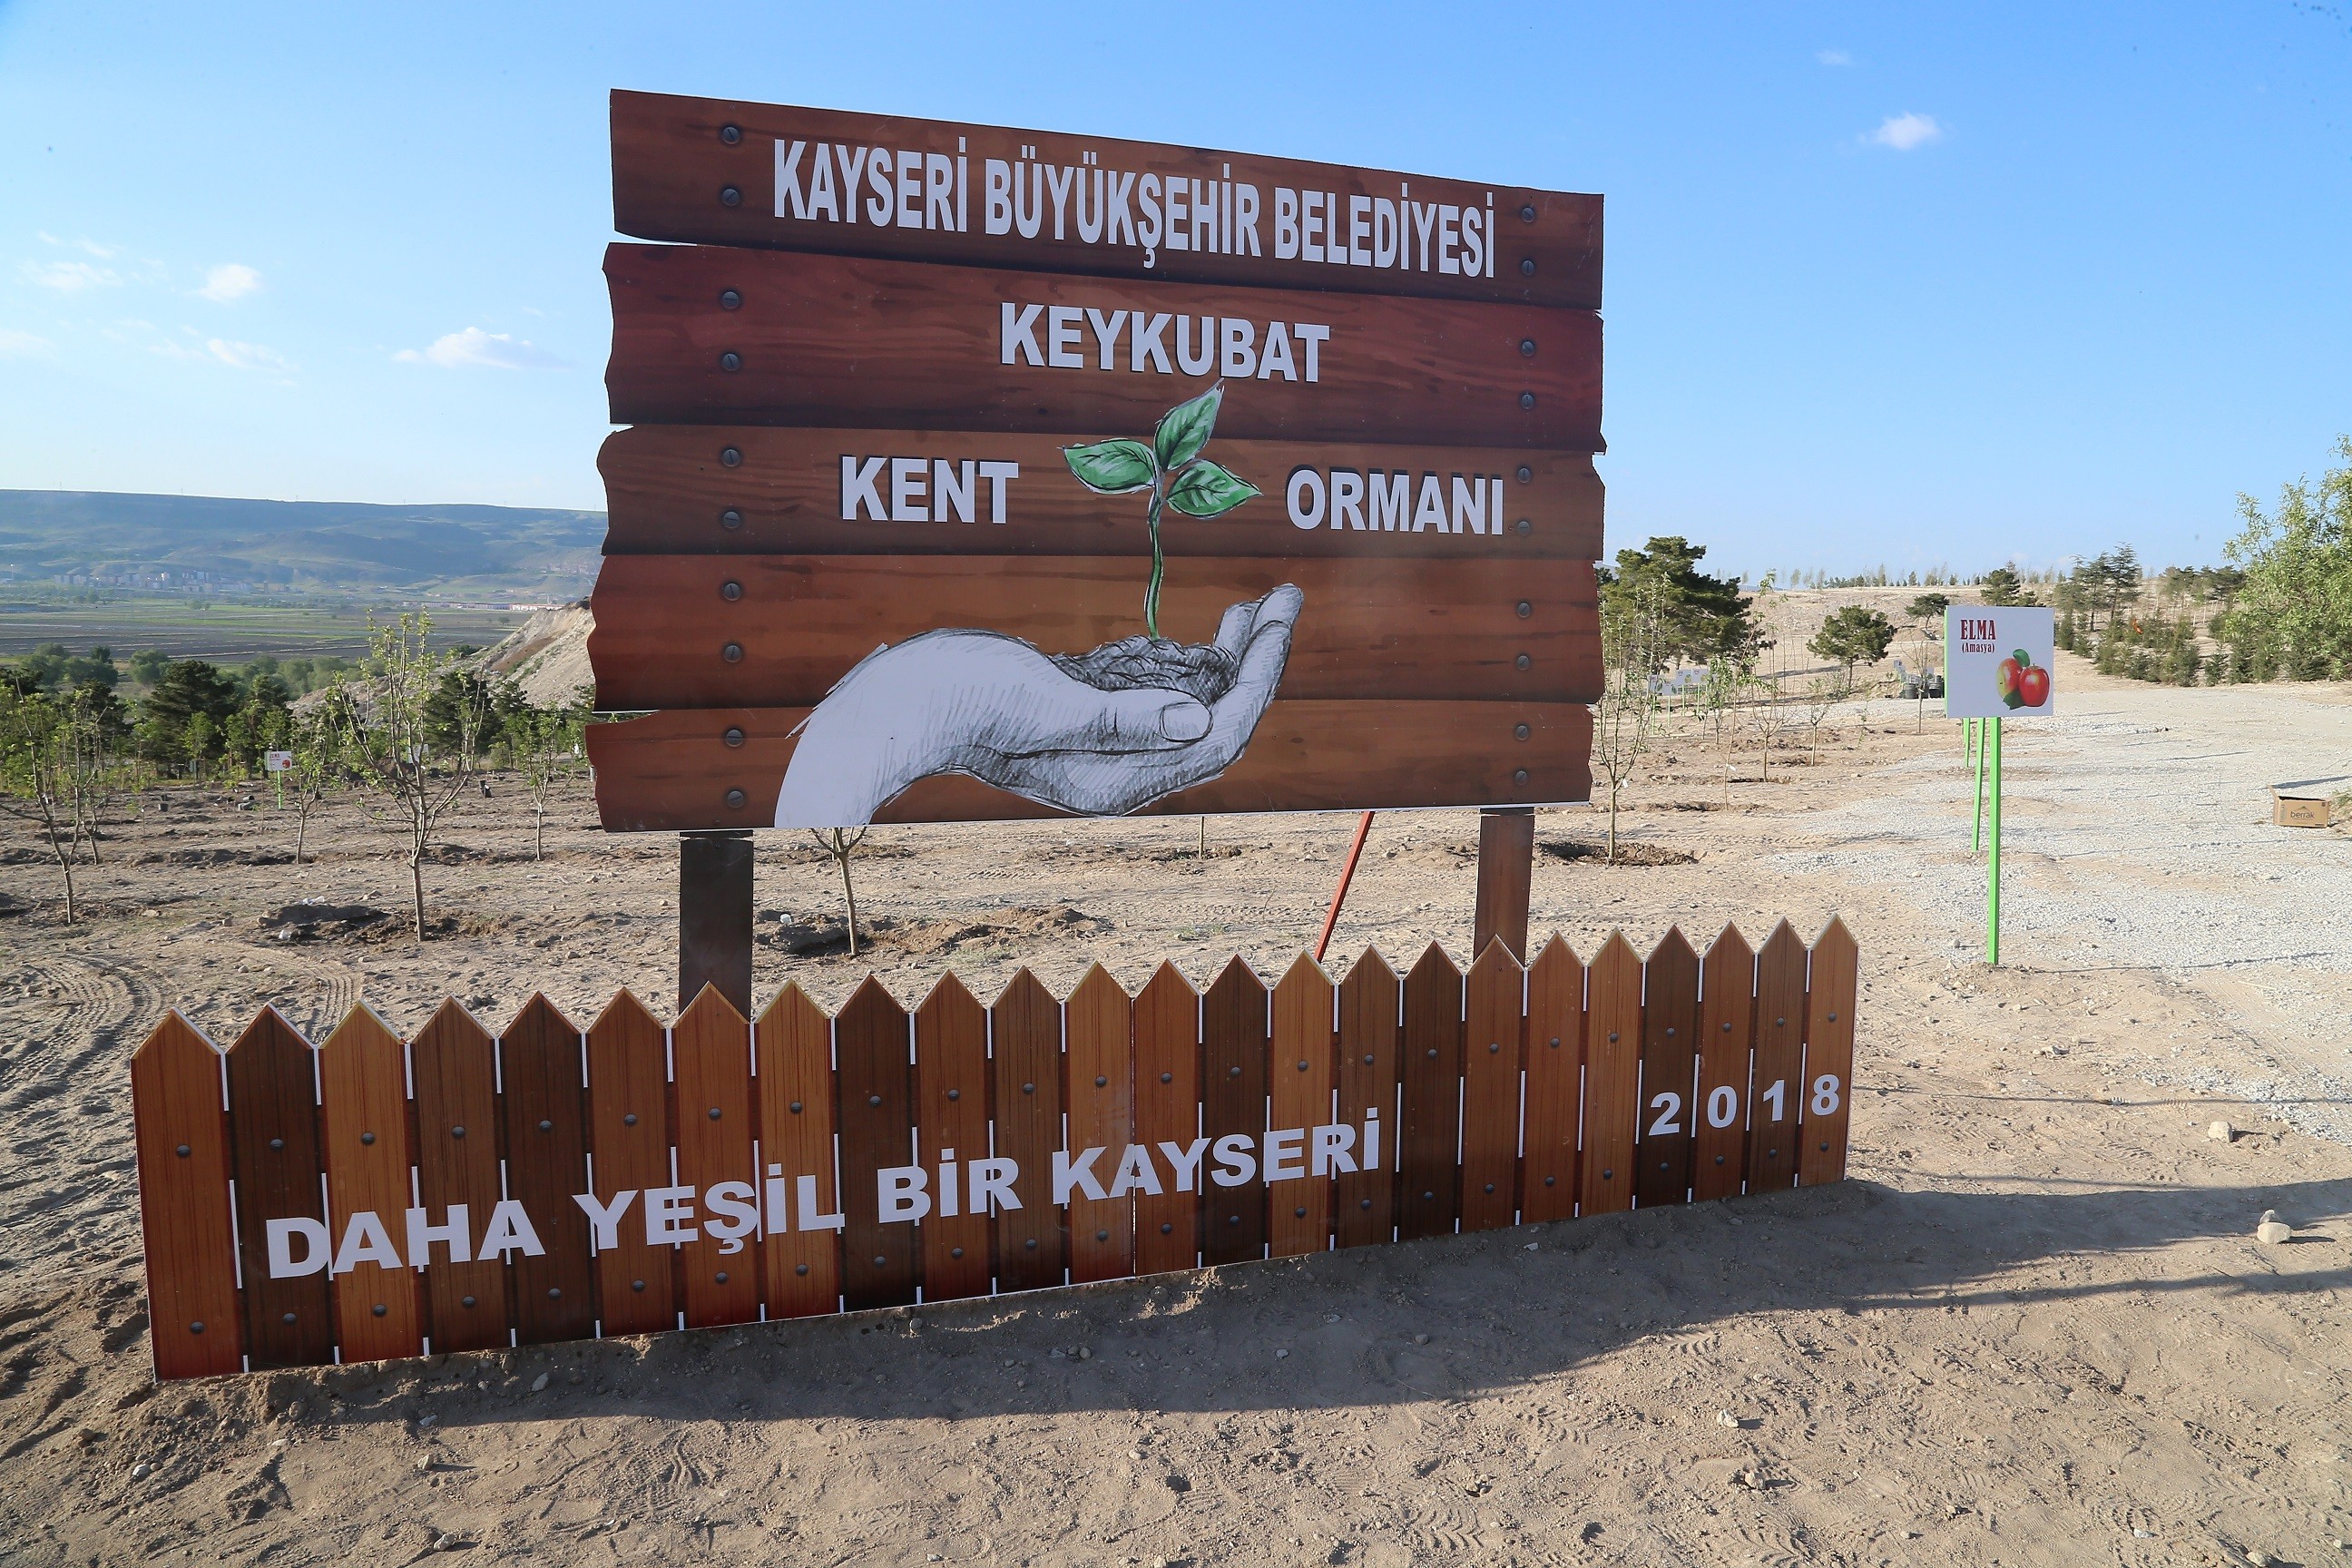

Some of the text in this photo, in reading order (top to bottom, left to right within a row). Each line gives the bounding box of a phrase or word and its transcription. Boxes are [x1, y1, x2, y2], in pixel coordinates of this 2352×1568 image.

[774, 136, 1494, 279] KAYSERİ BÜYÜKŞEHİR BELEDİYESİ
[1000, 301, 1330, 383] KEYKUBAT
[840, 456, 1504, 536] KENT ORMANI
[1960, 619, 1995, 640] ELMA
[1962, 642, 1994, 653] (Amasya)
[2290, 810, 2315, 818] berrak
[266, 1073, 1840, 1279] DAHA YEŞİL BİR KAYSERİ 2018
